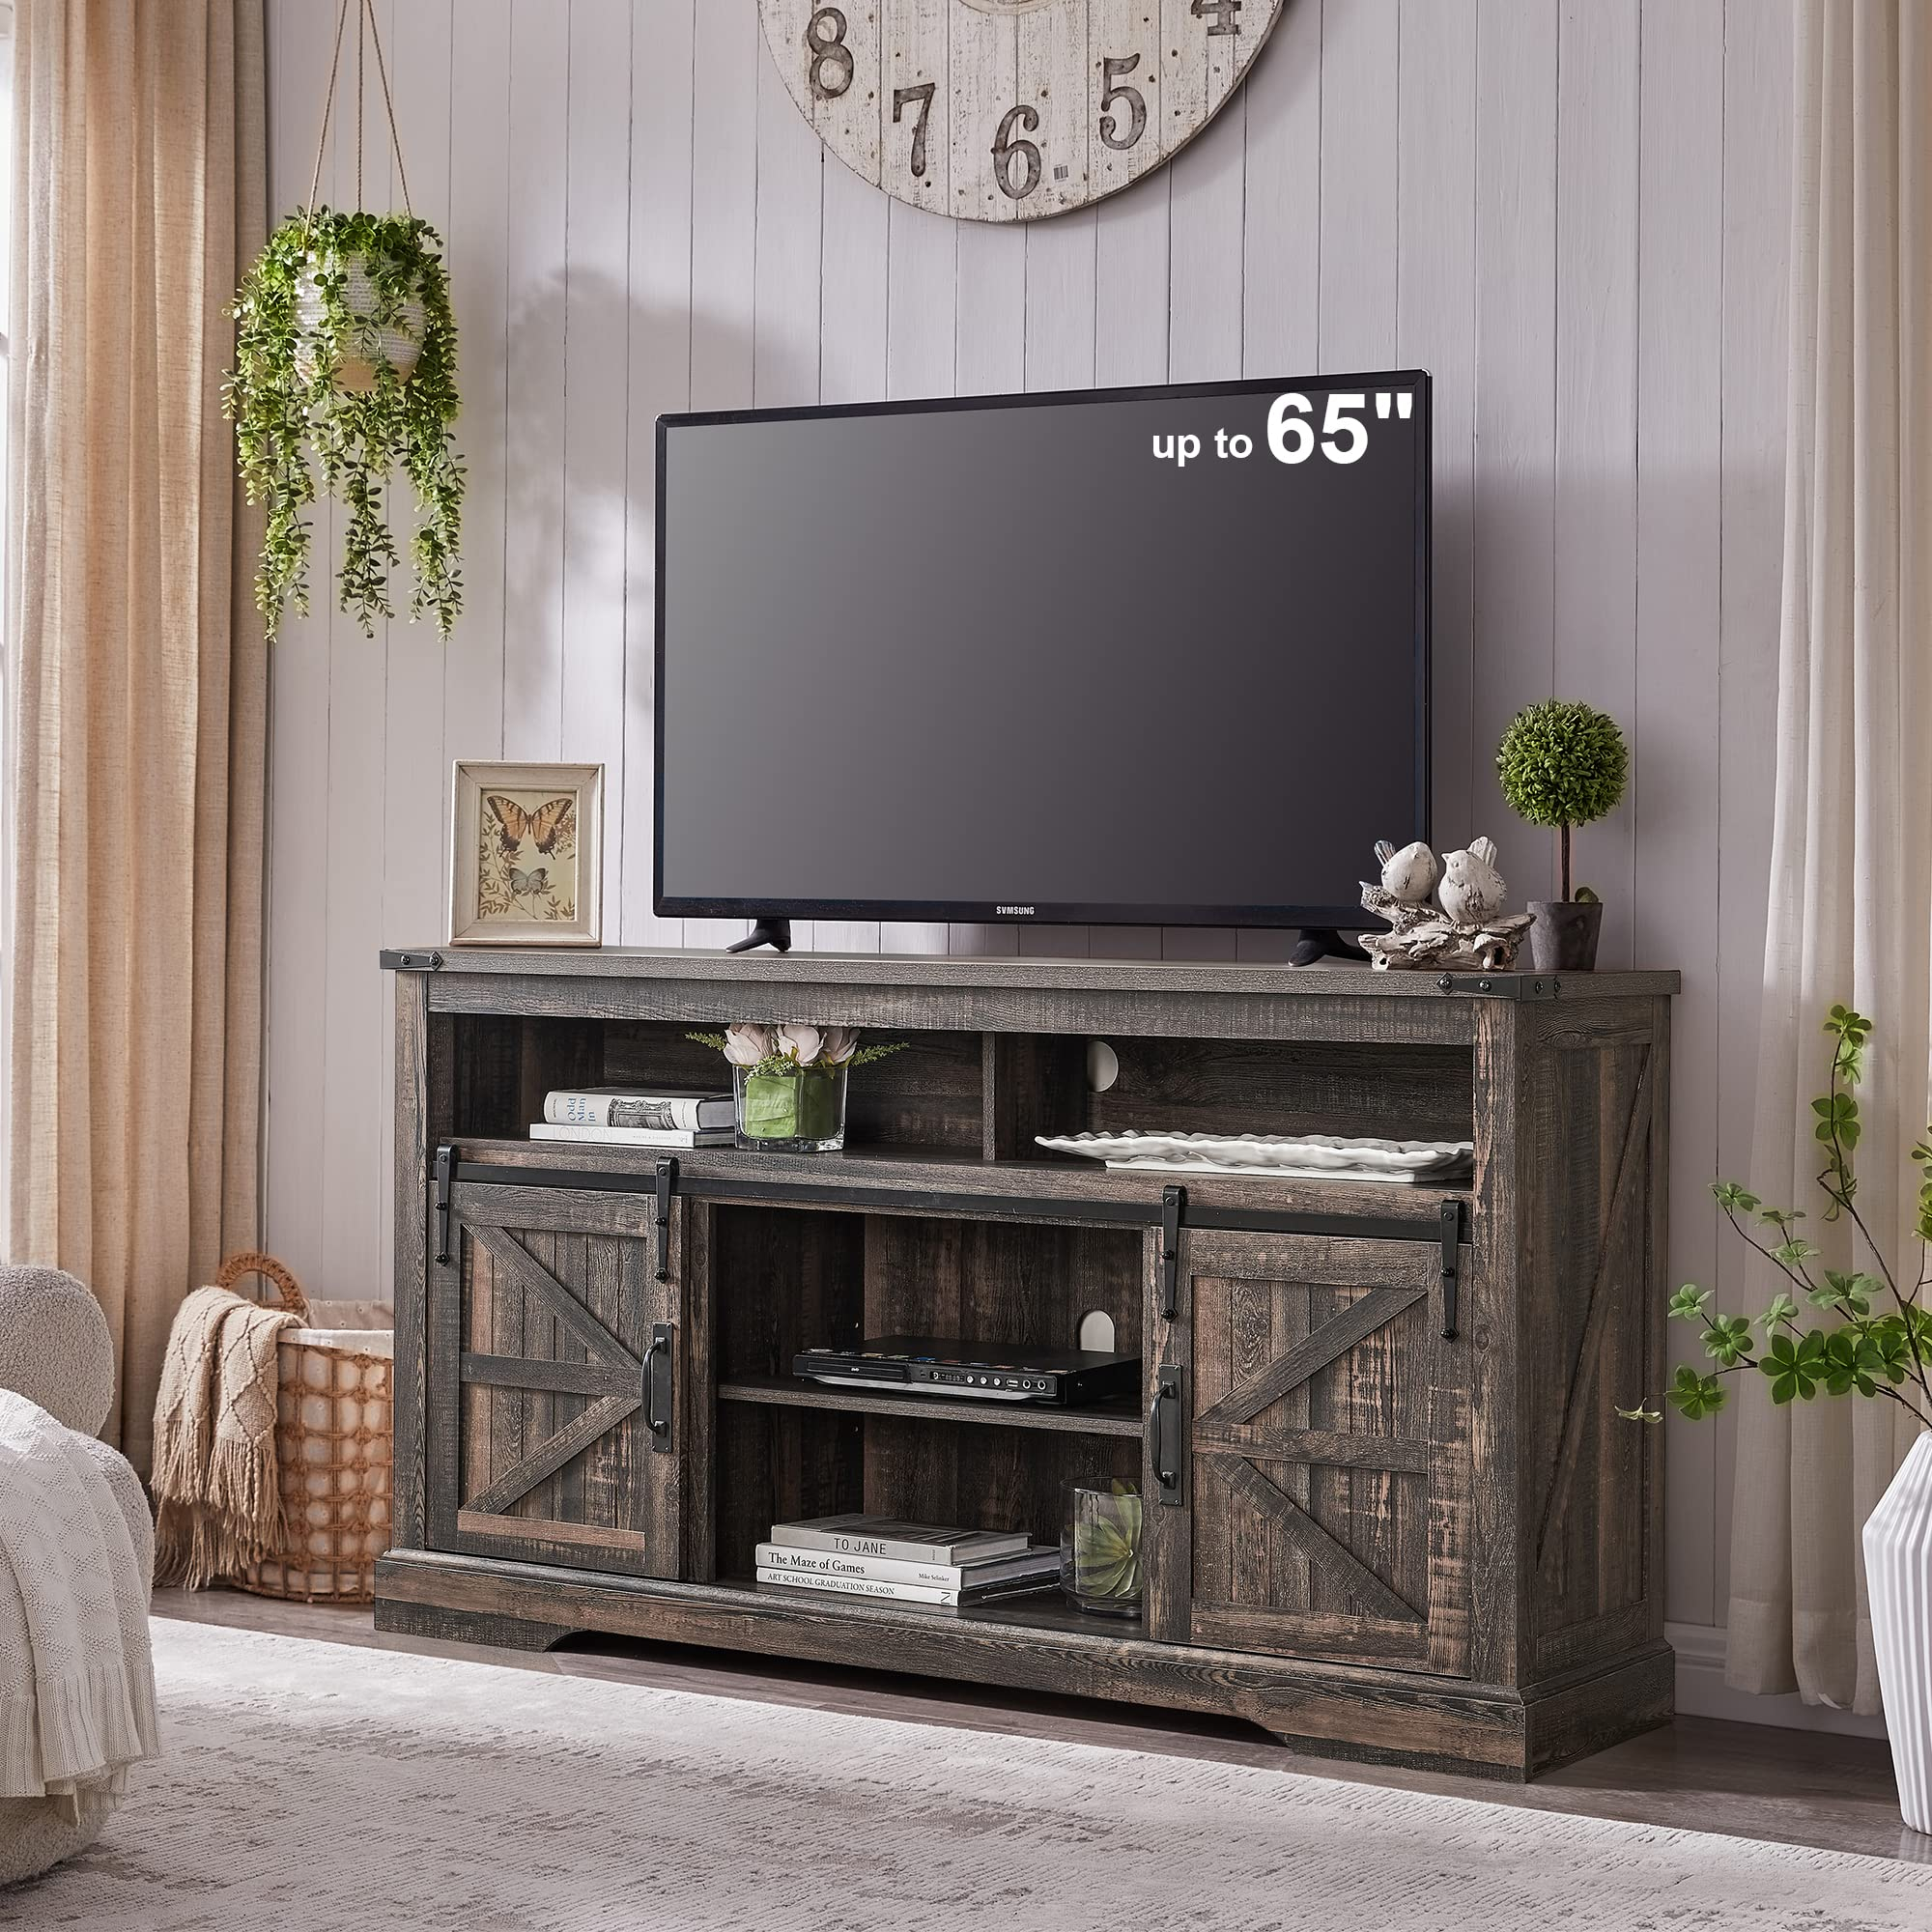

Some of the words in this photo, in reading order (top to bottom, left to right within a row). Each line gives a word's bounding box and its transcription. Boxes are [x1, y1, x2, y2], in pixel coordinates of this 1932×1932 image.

[806, 6, 855, 99] 8
[1099, 52, 1148, 151] 5
[892, 82, 936, 178] 7
[990, 104, 1042, 200] 6
[567, 1097, 577, 1122] Odd
[577, 1097, 586, 1122] Man
[553, 1126, 612, 1141] LONDON
[834, 1537, 850, 1550] TO
[854, 1540, 888, 1555] JANE
[768, 1551, 787, 1565] The
[790, 1554, 817, 1569] Maze
[818, 1558, 831, 1570] of
[832, 1559, 866, 1575] Games
[767, 1573, 784, 1581] ART
[782, 1575, 814, 1586] SCHOOL
[814, 1578, 866, 1592] GRADUATION
[866, 1584, 895, 1596] SEASON
